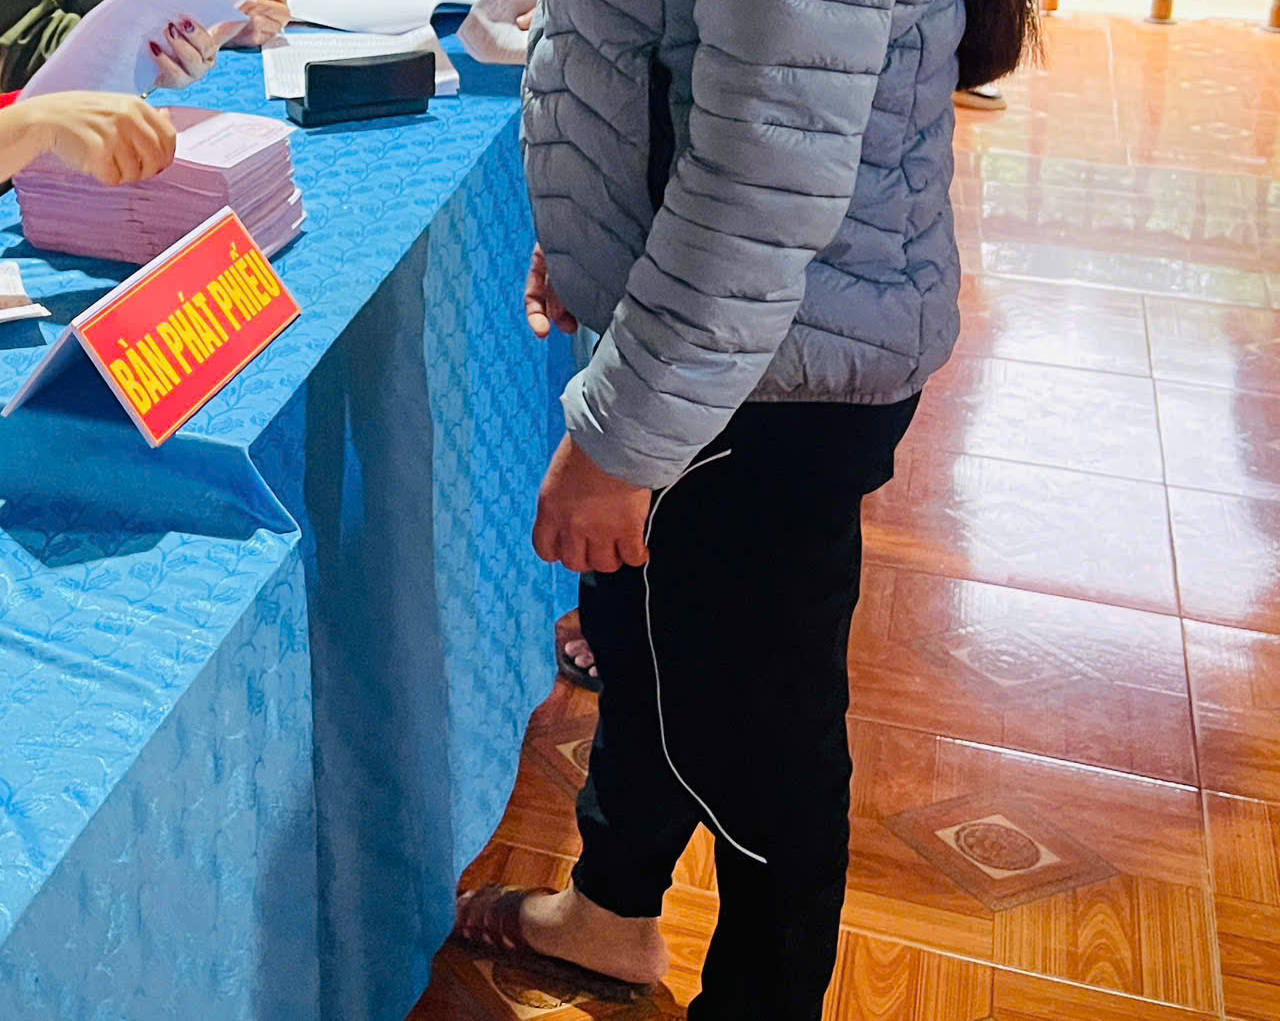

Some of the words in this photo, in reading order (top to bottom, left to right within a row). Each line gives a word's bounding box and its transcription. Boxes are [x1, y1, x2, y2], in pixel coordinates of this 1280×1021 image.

[109, 337, 182, 416] BÀN
[157, 290, 230, 375] PHÁT
[206, 241, 281, 332] PHIẾU
